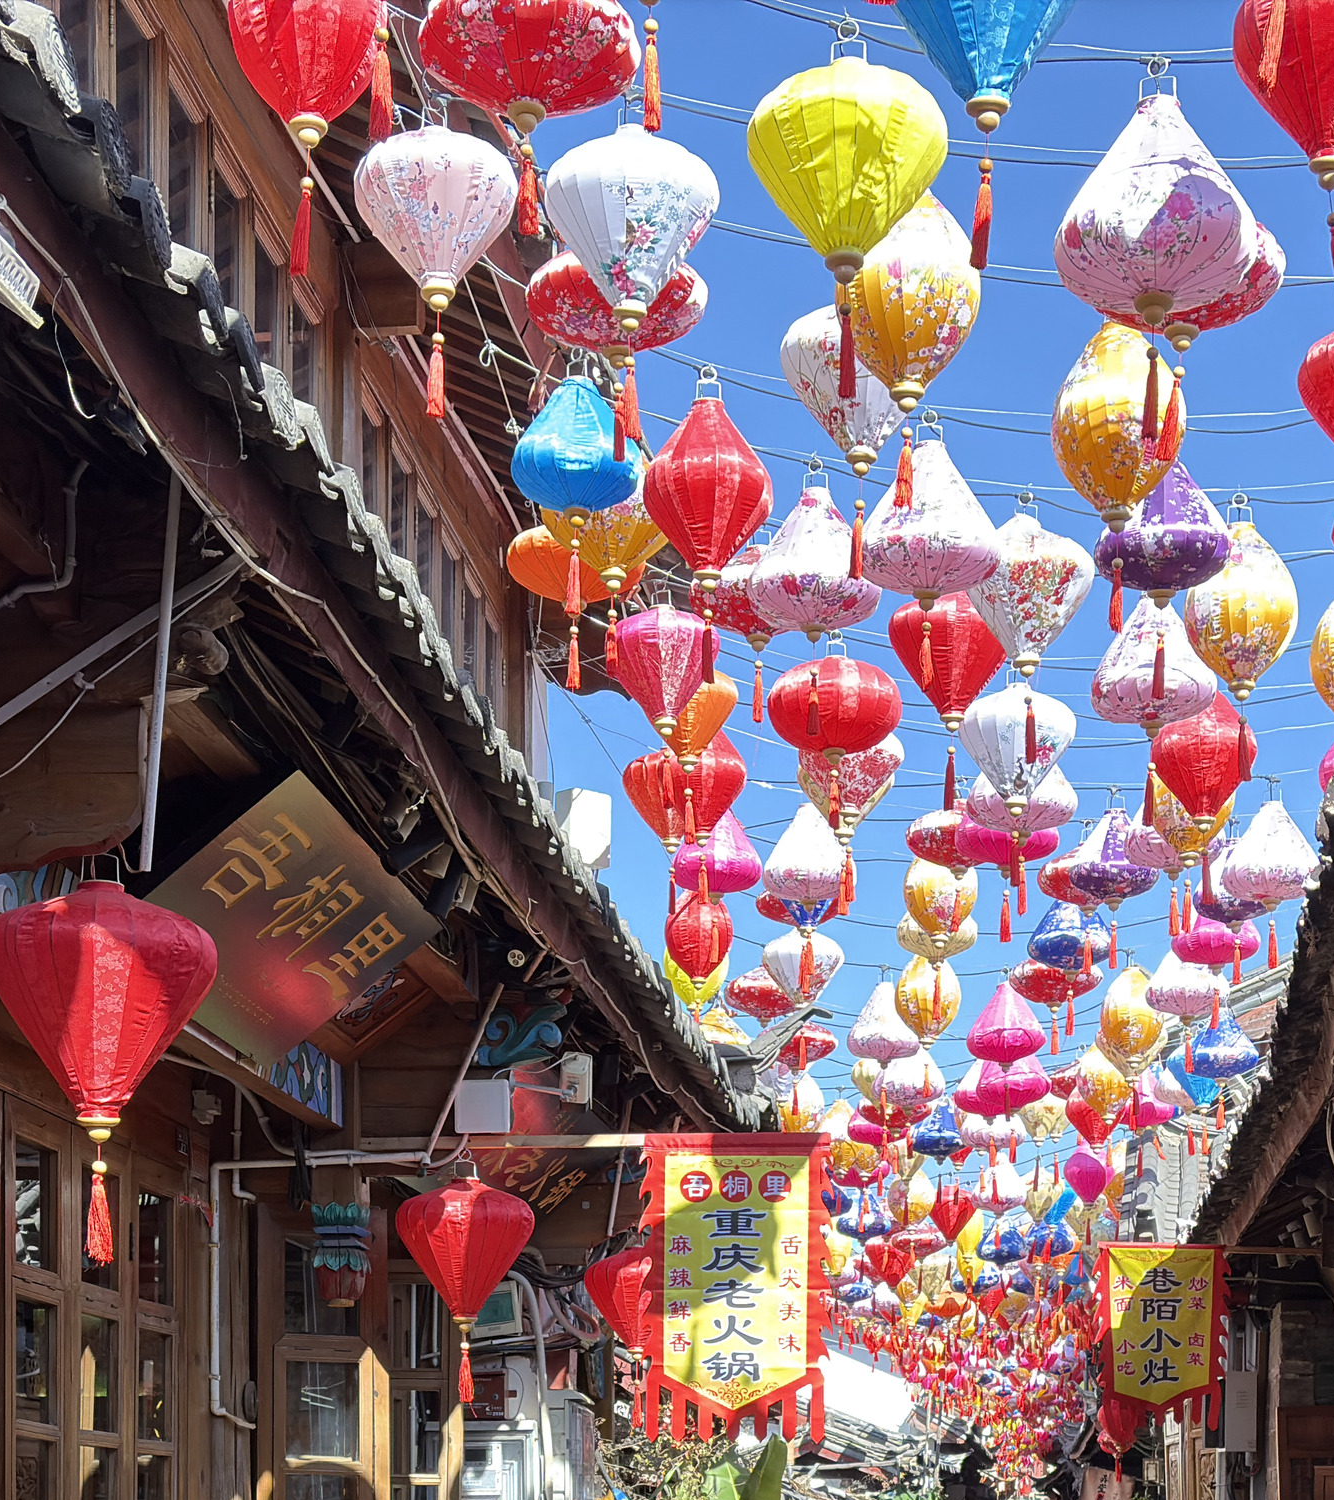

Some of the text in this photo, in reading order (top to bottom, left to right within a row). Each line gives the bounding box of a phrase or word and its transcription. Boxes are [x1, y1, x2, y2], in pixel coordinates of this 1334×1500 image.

[202, 812, 407, 998] 吾桐里
[682, 1174, 790, 1199] 吾桐里
[668, 1234, 693, 1353] 麻辣鲜香
[701, 1207, 767, 1382] 重庆老火锅
[778, 1235, 802, 1353] 舌尖美味
[1113, 1276, 1135, 1376] 米面 小吃
[1139, 1267, 1183, 1386] 巷陌小灶
[1187, 1276, 1209, 1367] 炒菜 卤菜
